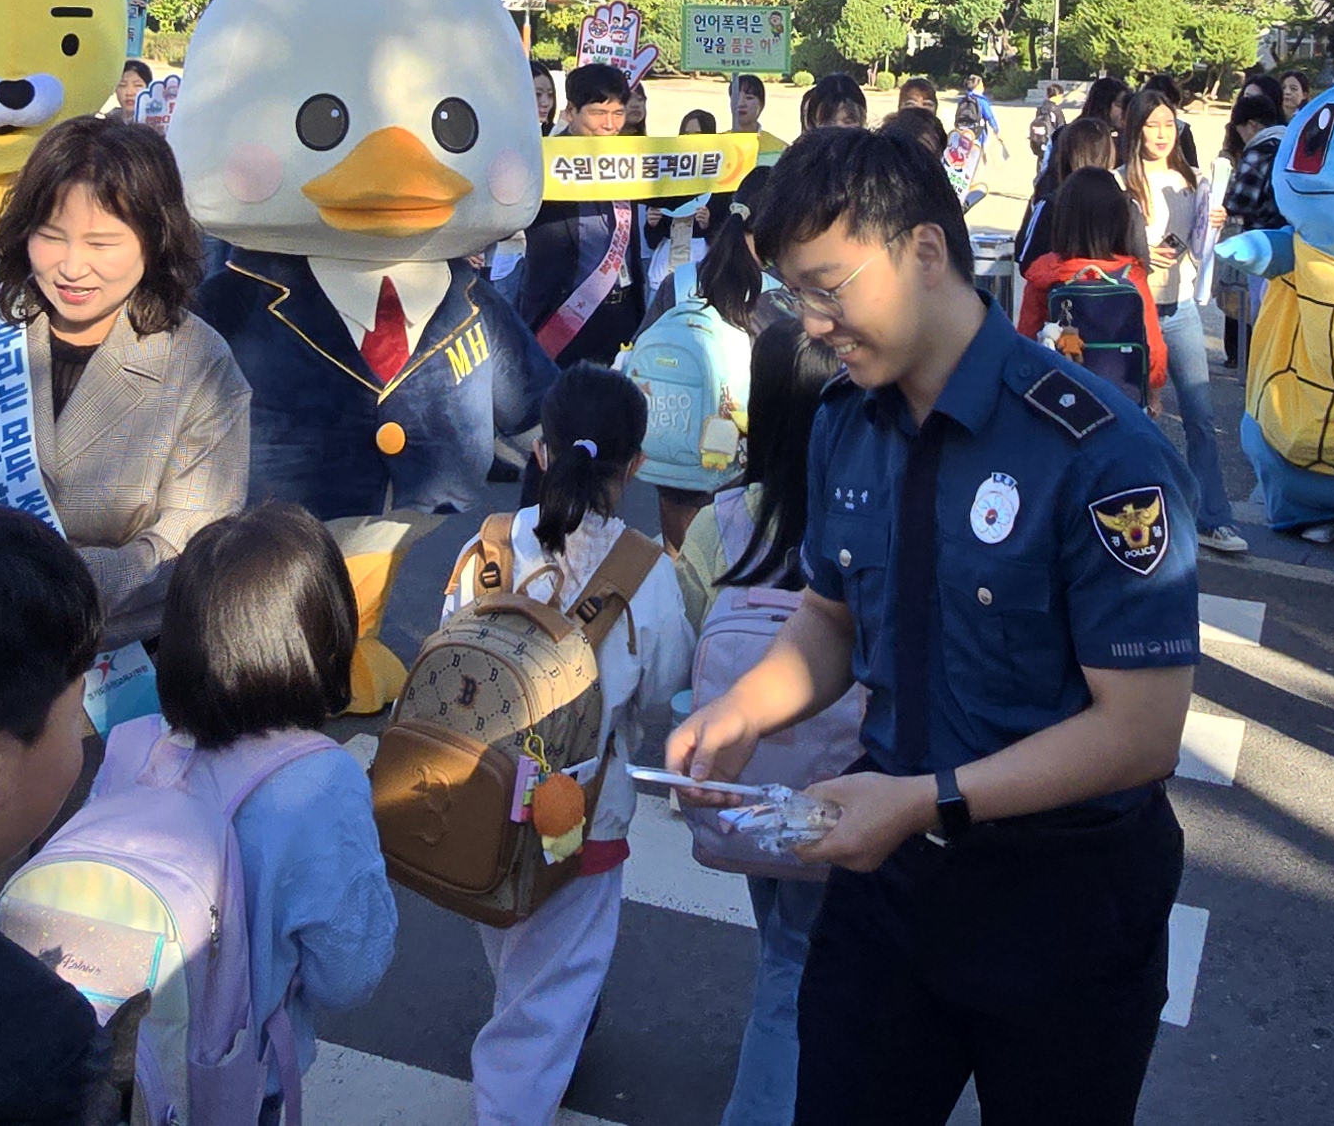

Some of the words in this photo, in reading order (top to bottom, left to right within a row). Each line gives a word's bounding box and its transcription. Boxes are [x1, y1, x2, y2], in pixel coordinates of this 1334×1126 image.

[694, 14, 764, 33] 언어폭력은
[731, 37, 755, 54] 품은
[555, 156, 593, 181] 수원
[598, 156, 635, 180] 언어
[641, 154, 697, 179] 품격의
[701, 153, 721, 176] 달
[445, 322, 490, 386] MH
[1, 416, 36, 484] 모두
[1124, 545, 1157, 560] POLICE
